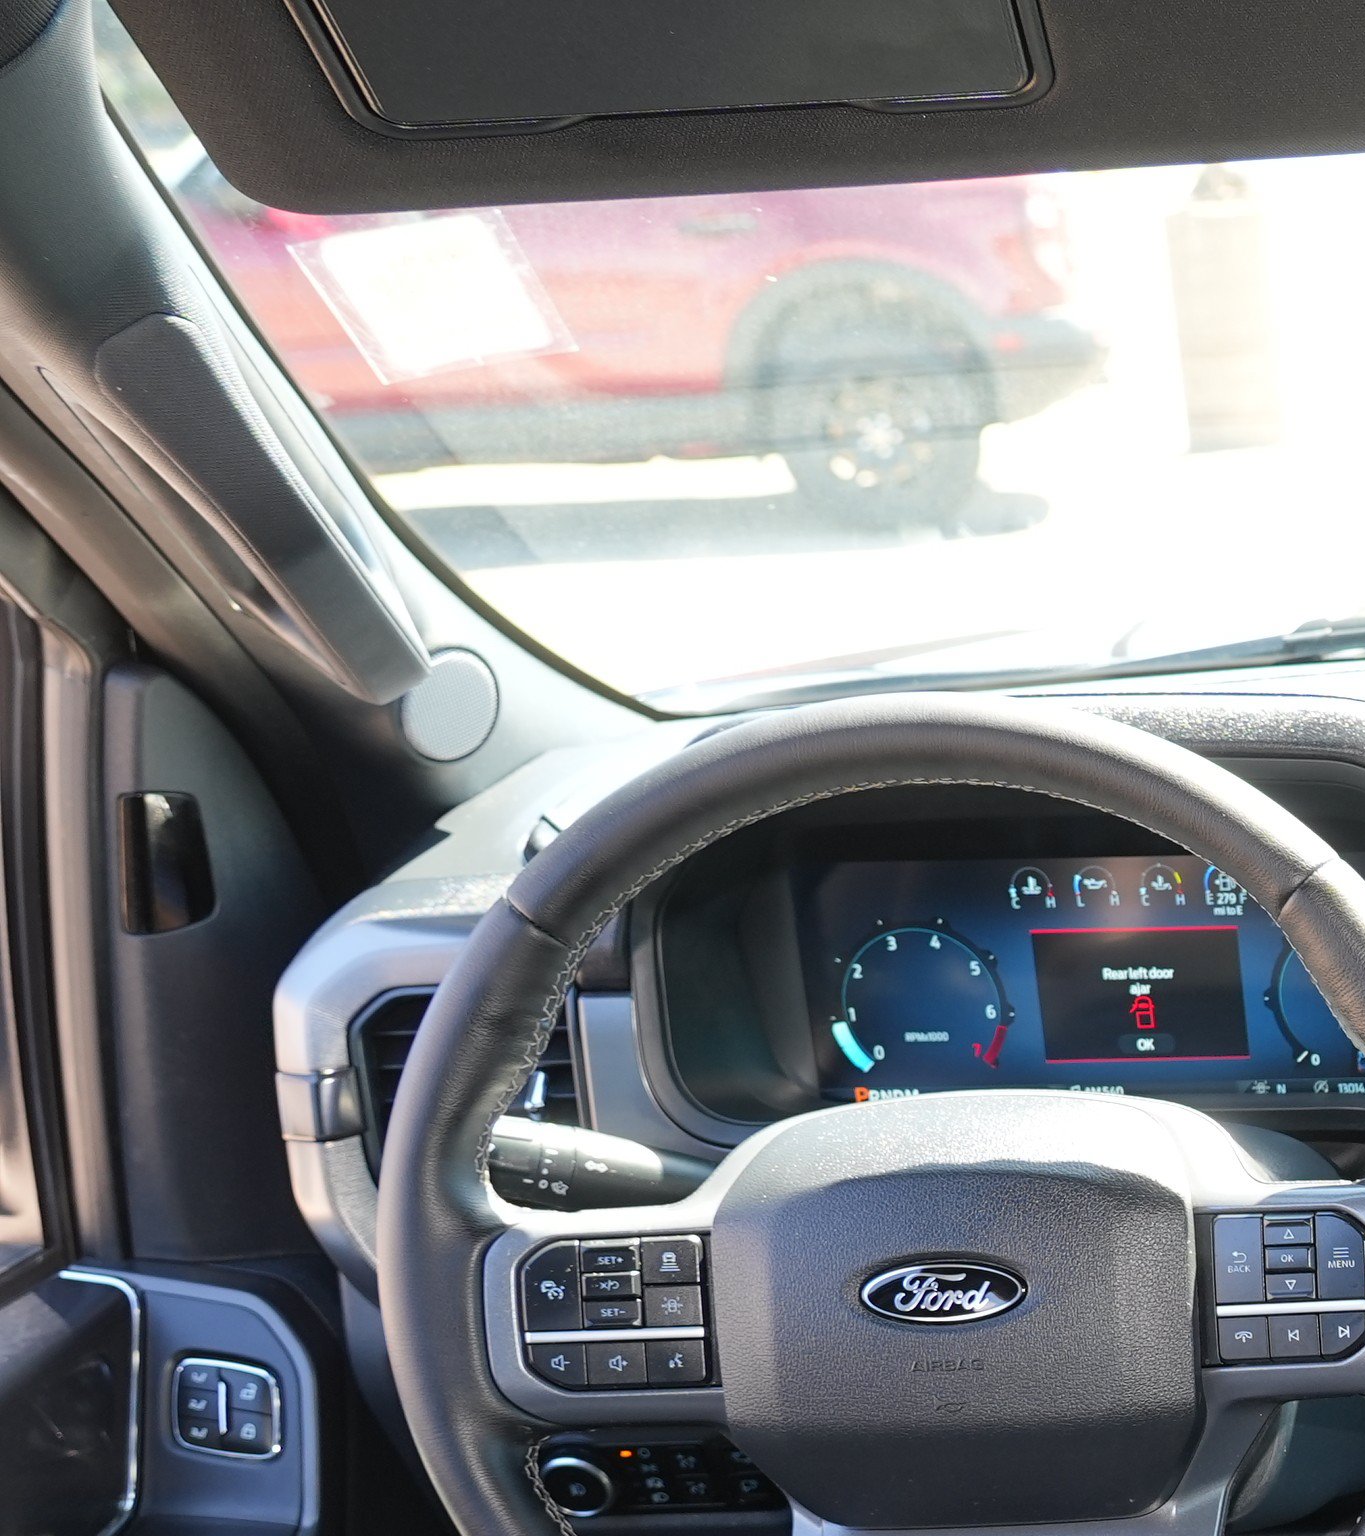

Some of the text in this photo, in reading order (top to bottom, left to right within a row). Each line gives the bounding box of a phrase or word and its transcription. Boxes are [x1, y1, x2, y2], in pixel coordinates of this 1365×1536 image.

[1045, 896, 1056, 909] H
[1076, 896, 1085, 908] L
[1109, 895, 1120, 906] H
[1175, 894, 1186, 906] H
[1205, 893, 1214, 905] E
[1217, 892, 1237, 905] 279
[886, 936, 898, 951] 3
[929, 935, 941, 950] 4
[852, 963, 863, 979] 2
[969, 961, 981, 976] 5
[1102, 966, 1174, 980] Rear left door
[1129, 982, 1152, 996] ajar
[848, 1007, 857, 1022] 1
[985, 1004, 997, 1019] 6
[972, 1043, 983, 1057] 7
[1136, 1038, 1155, 1051] OK
[873, 1045, 885, 1060] 0
[1310, 1054, 1321, 1066] 0
[1276, 1084, 1287, 1094] N
[598, 1256, 624, 1265] SET+
[1280, 1254, 1294, 1263] OK
[1327, 1260, 1355, 1268] MENU
[1227, 1265, 1251, 1273] BACK
[894, 1273, 991, 1312] Ford
[911, 1359, 984, 1373] AIRBAG
